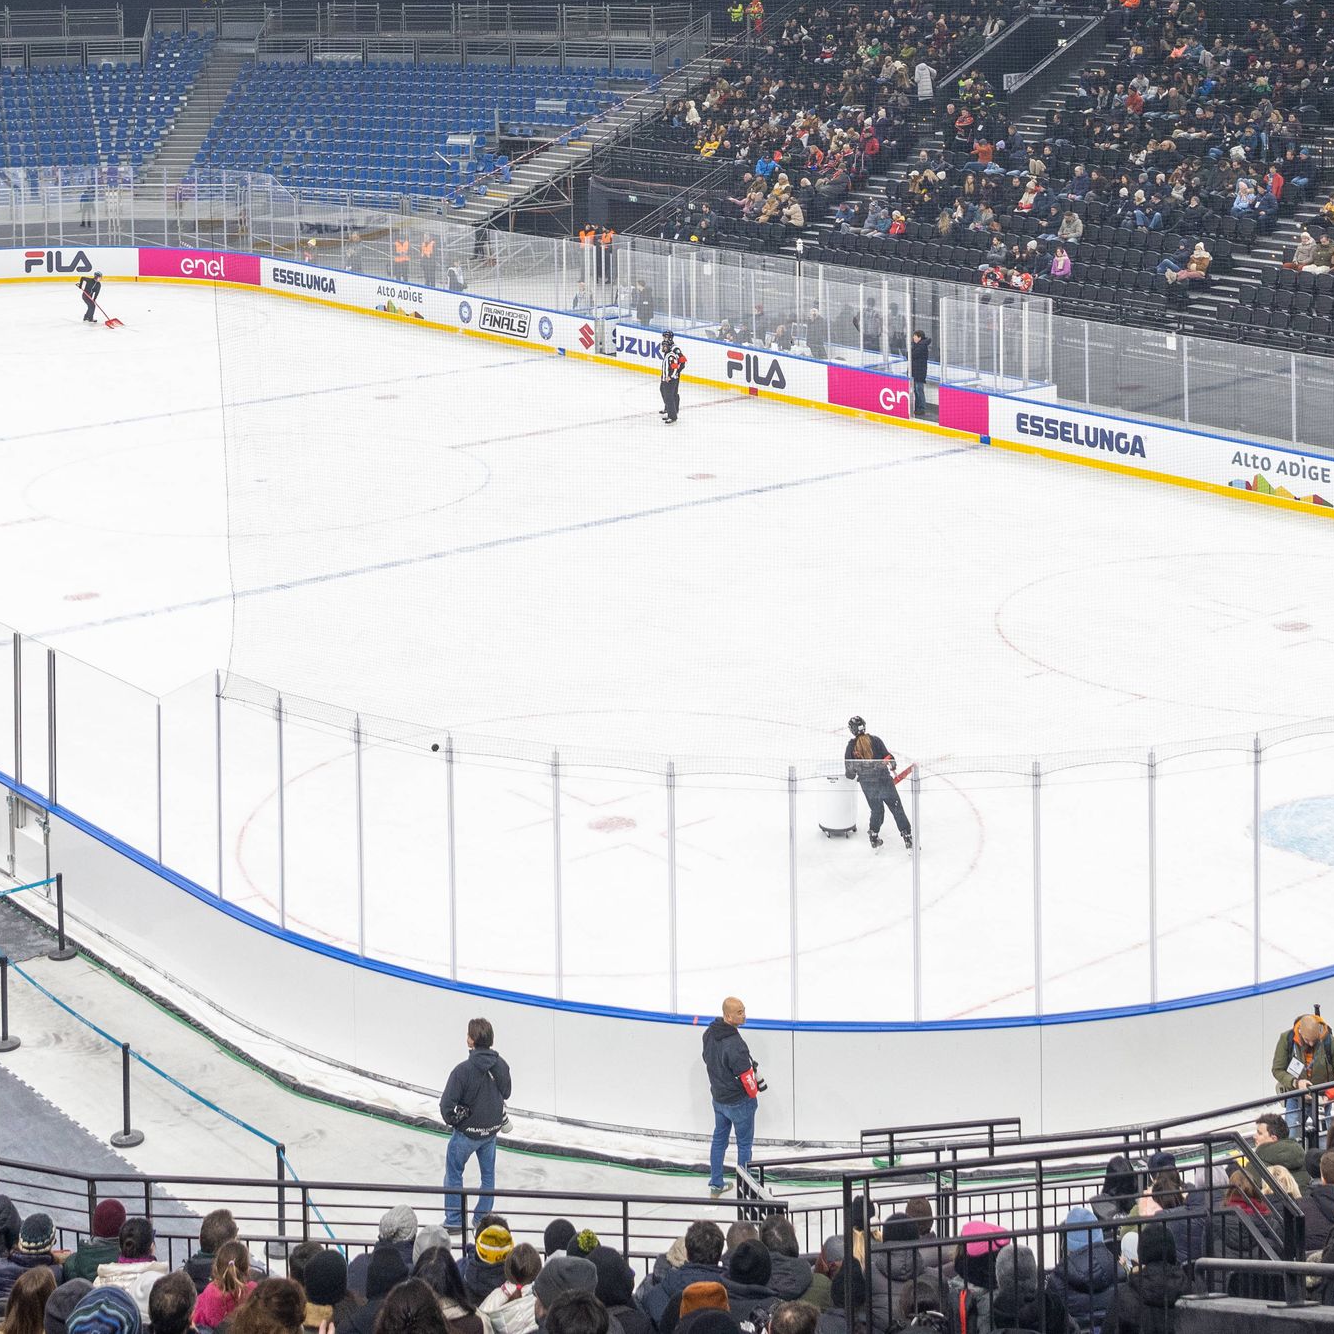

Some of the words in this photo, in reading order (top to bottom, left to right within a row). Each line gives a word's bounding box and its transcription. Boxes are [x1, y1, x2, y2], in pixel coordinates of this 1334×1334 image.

[25, 250, 93, 274] FILA
[181, 256, 225, 278] enel
[273, 268, 337, 294] ESSELUNGA
[483, 307, 505, 316] MILANO
[483, 314, 527, 334] FINALS
[727, 350, 787, 390] FILA
[1017, 412, 1146, 458] ESSELUNGA
